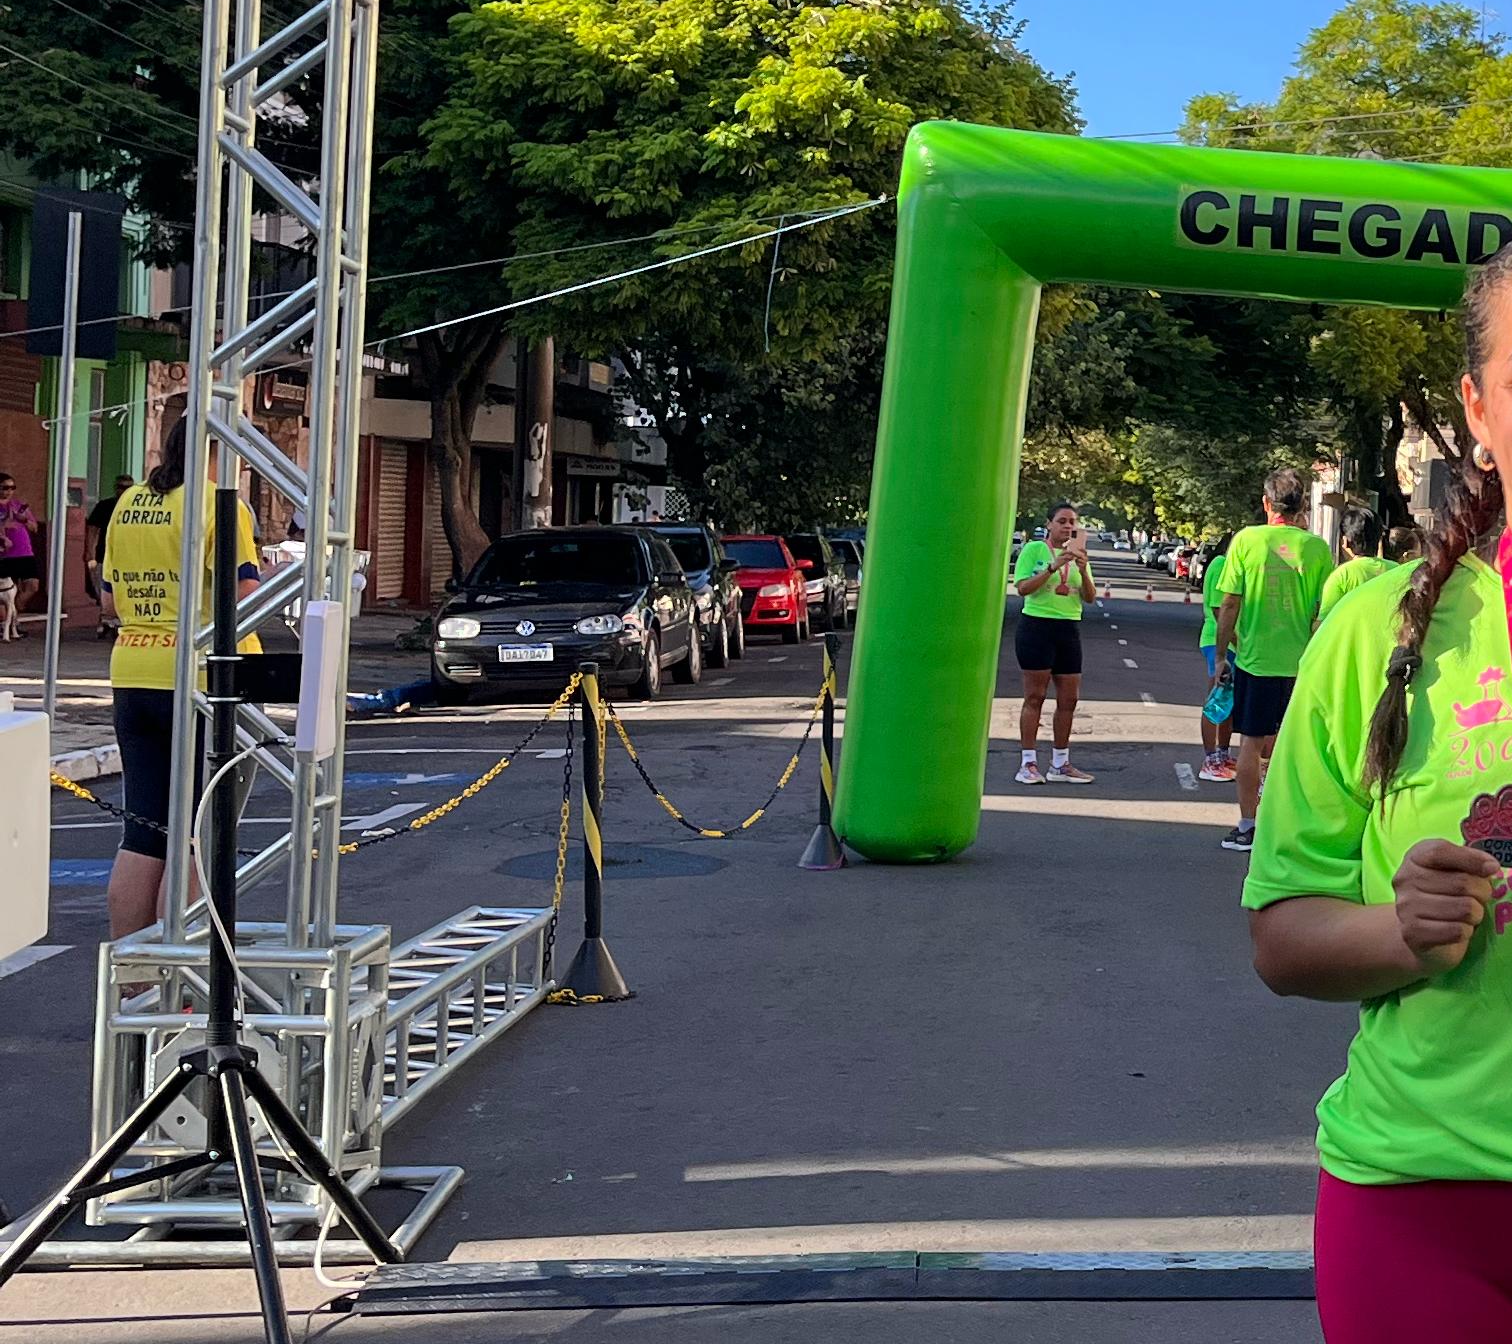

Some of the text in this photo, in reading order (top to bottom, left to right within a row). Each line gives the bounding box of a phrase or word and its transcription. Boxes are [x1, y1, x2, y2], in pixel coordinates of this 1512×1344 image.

[131, 493, 165, 507] RITA
[112, 568, 120, 583] O
[122, 571, 141, 585] que
[143, 568, 165, 582] não
[127, 585, 166, 598] desafia
[134, 599, 161, 617] NÃO
